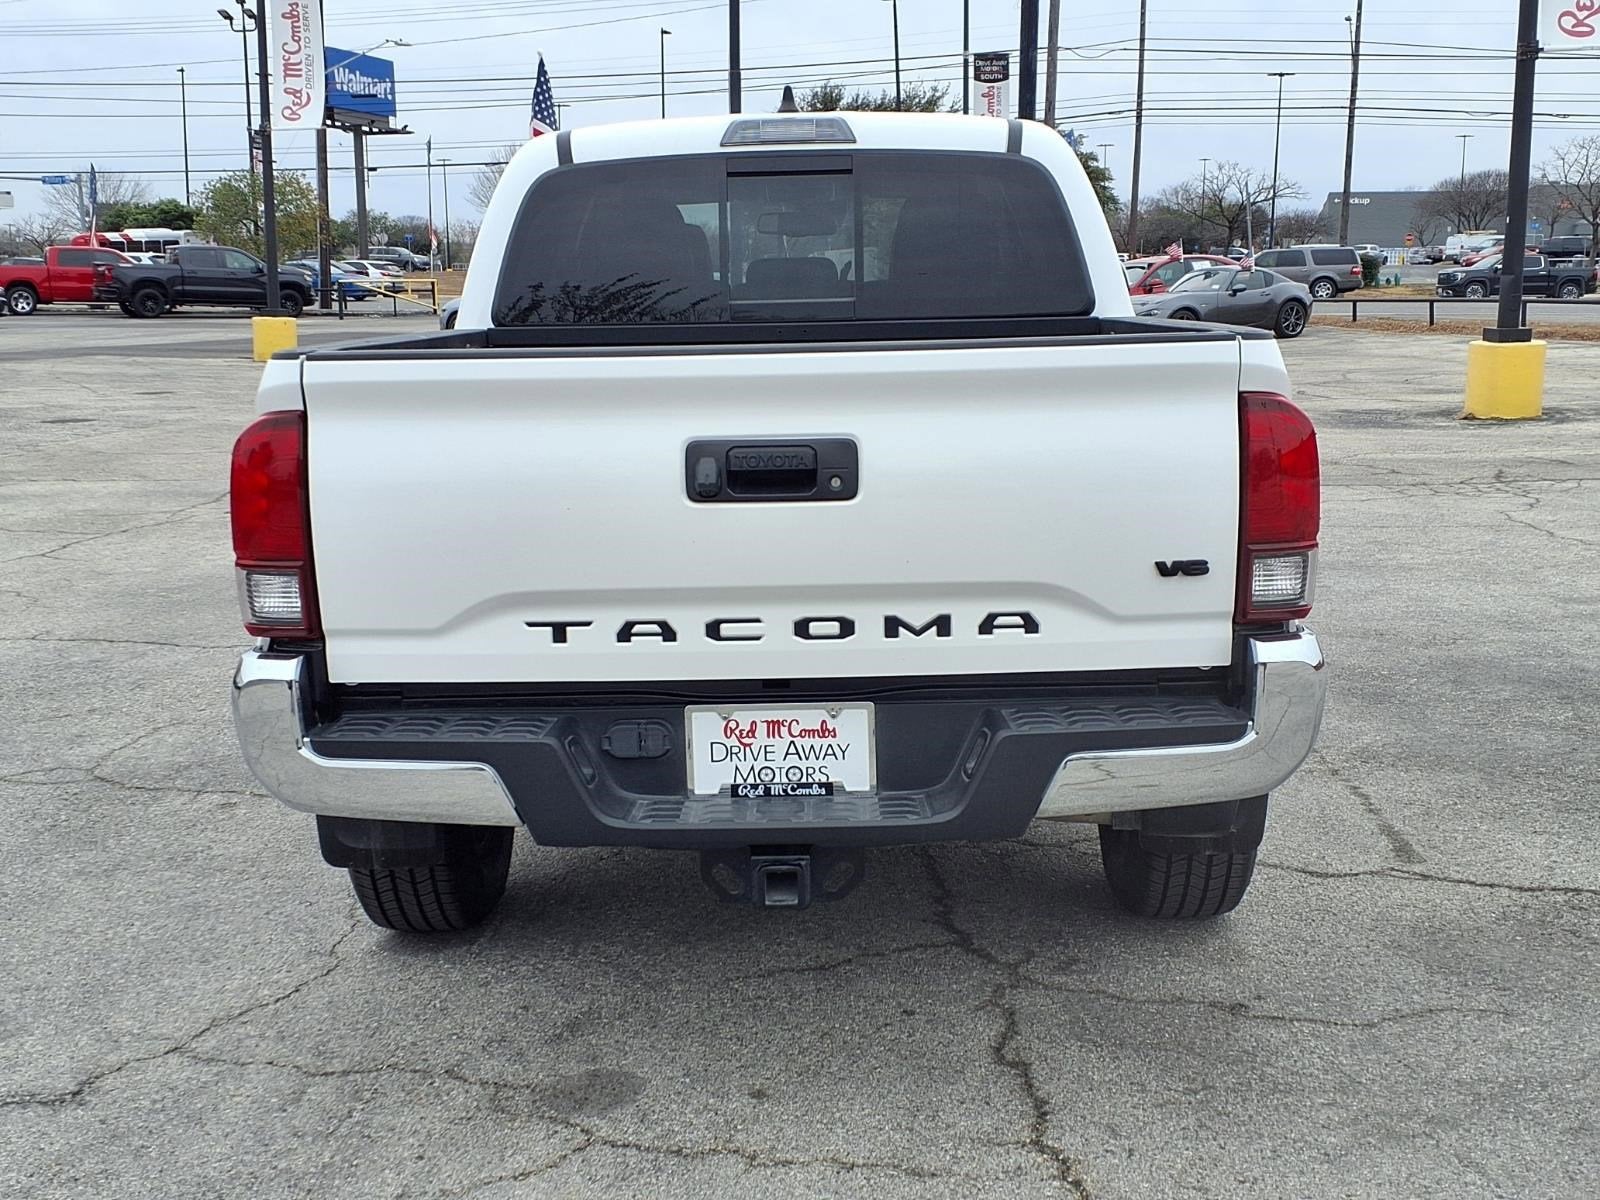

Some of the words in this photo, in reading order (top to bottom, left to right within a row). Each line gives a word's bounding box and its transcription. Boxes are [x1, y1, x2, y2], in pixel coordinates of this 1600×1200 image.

[302, 3, 310, 33] SERVE
[1558, 0, 1600, 37] Re
[281, 1, 303, 84] McCombs
[304, 38, 311, 50] TO
[304, 54, 312, 90] DRIVEN
[334, 67, 393, 100] Walmart
[281, 87, 312, 121] Red
[1349, 197, 1370, 206] ckup
[734, 454, 809, 468] TOYOTA
[1154, 559, 1210, 578] V6
[524, 611, 1040, 644] TACOMA
[723, 719, 757, 747] Red
[760, 718, 837, 740] McCombs
[710, 741, 776, 763] DRIVE
[783, 740, 850, 761] AWAY
[733, 763, 830, 784] MOTORS
[738, 784, 764, 798] Red
[766, 783, 827, 796] McCombs
